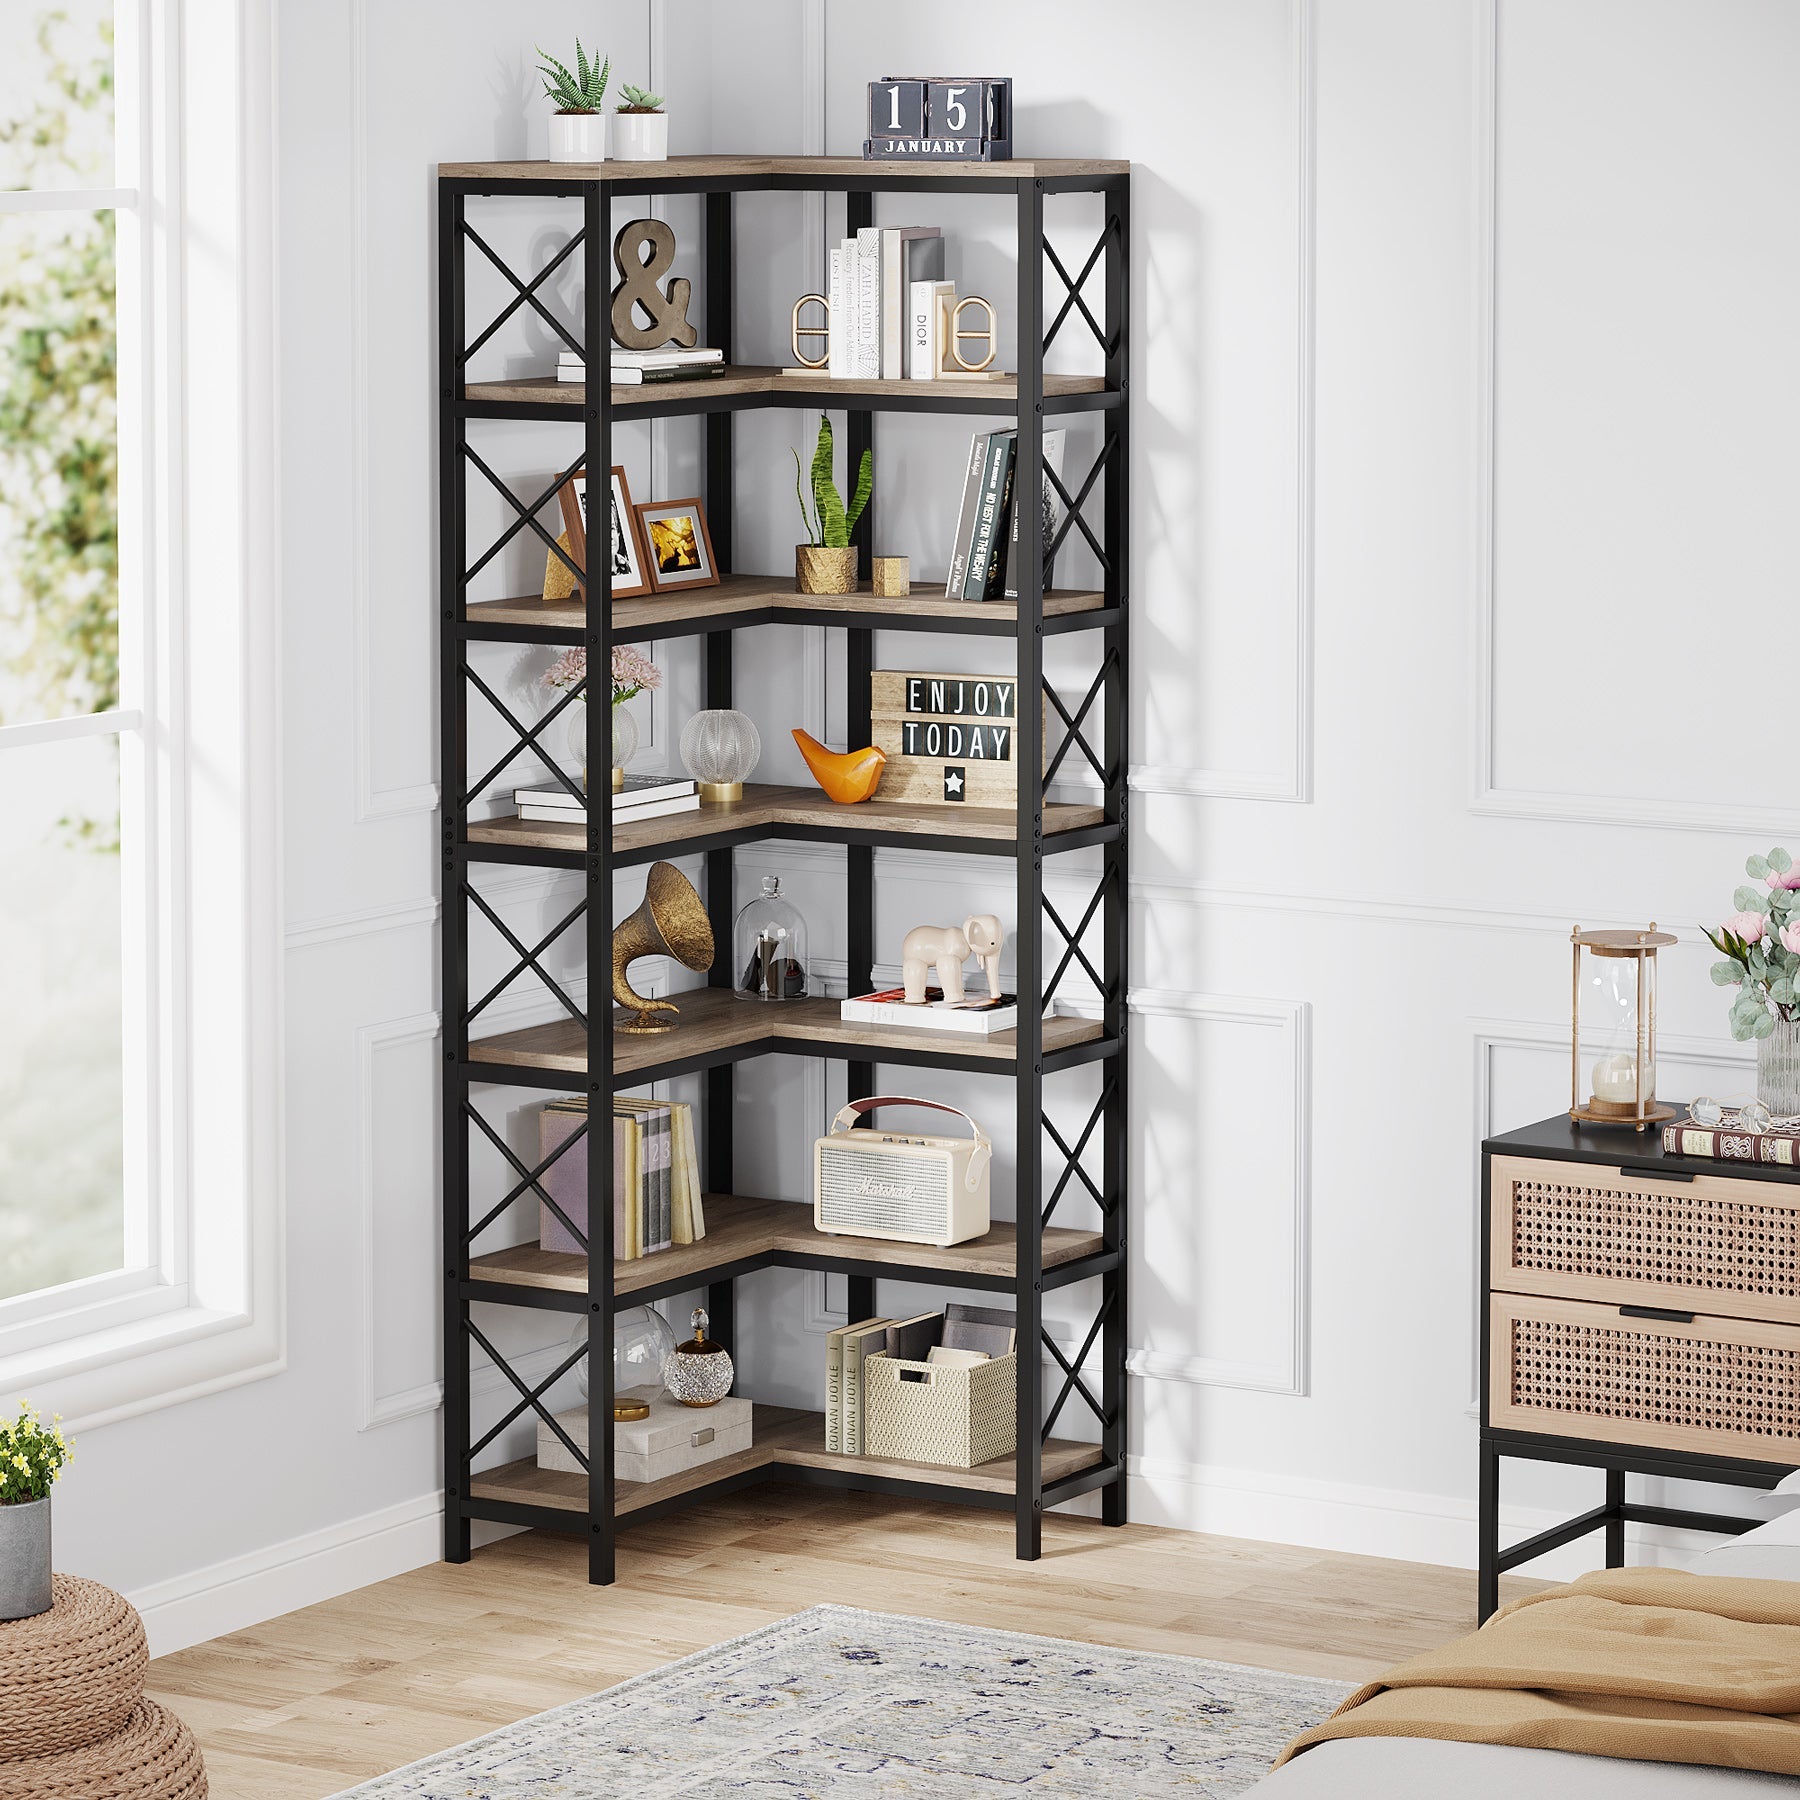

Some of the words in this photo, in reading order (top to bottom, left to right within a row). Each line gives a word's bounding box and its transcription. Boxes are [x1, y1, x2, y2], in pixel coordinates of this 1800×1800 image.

[887, 85, 902, 129] 1
[946, 88, 967, 131] 5
[885, 140, 967, 153] JANUARY
[611, 219, 697, 350] &
[861, 264, 872, 297] ZAHA
[861, 300, 872, 339] HADID
[916, 315, 927, 346] DIOR
[982, 503, 994, 522] REST
[986, 492, 997, 504] NO
[976, 538, 989, 554] THE
[980, 522, 992, 538] FOR
[971, 552, 986, 581] WEARY
[910, 680, 1011, 717] ENJOY
[905, 723, 1006, 760] TODAY
[652, 1143, 659, 1162] 2
[662, 1140, 670, 1159] 3
[855, 1177, 917, 1199] Marshall
[829, 1365, 839, 1403] DOYLE
[847, 1367, 856, 1405] DOYLE
[829, 1408, 839, 1451] CONAN
[847, 1410, 856, 1453] CONAN
